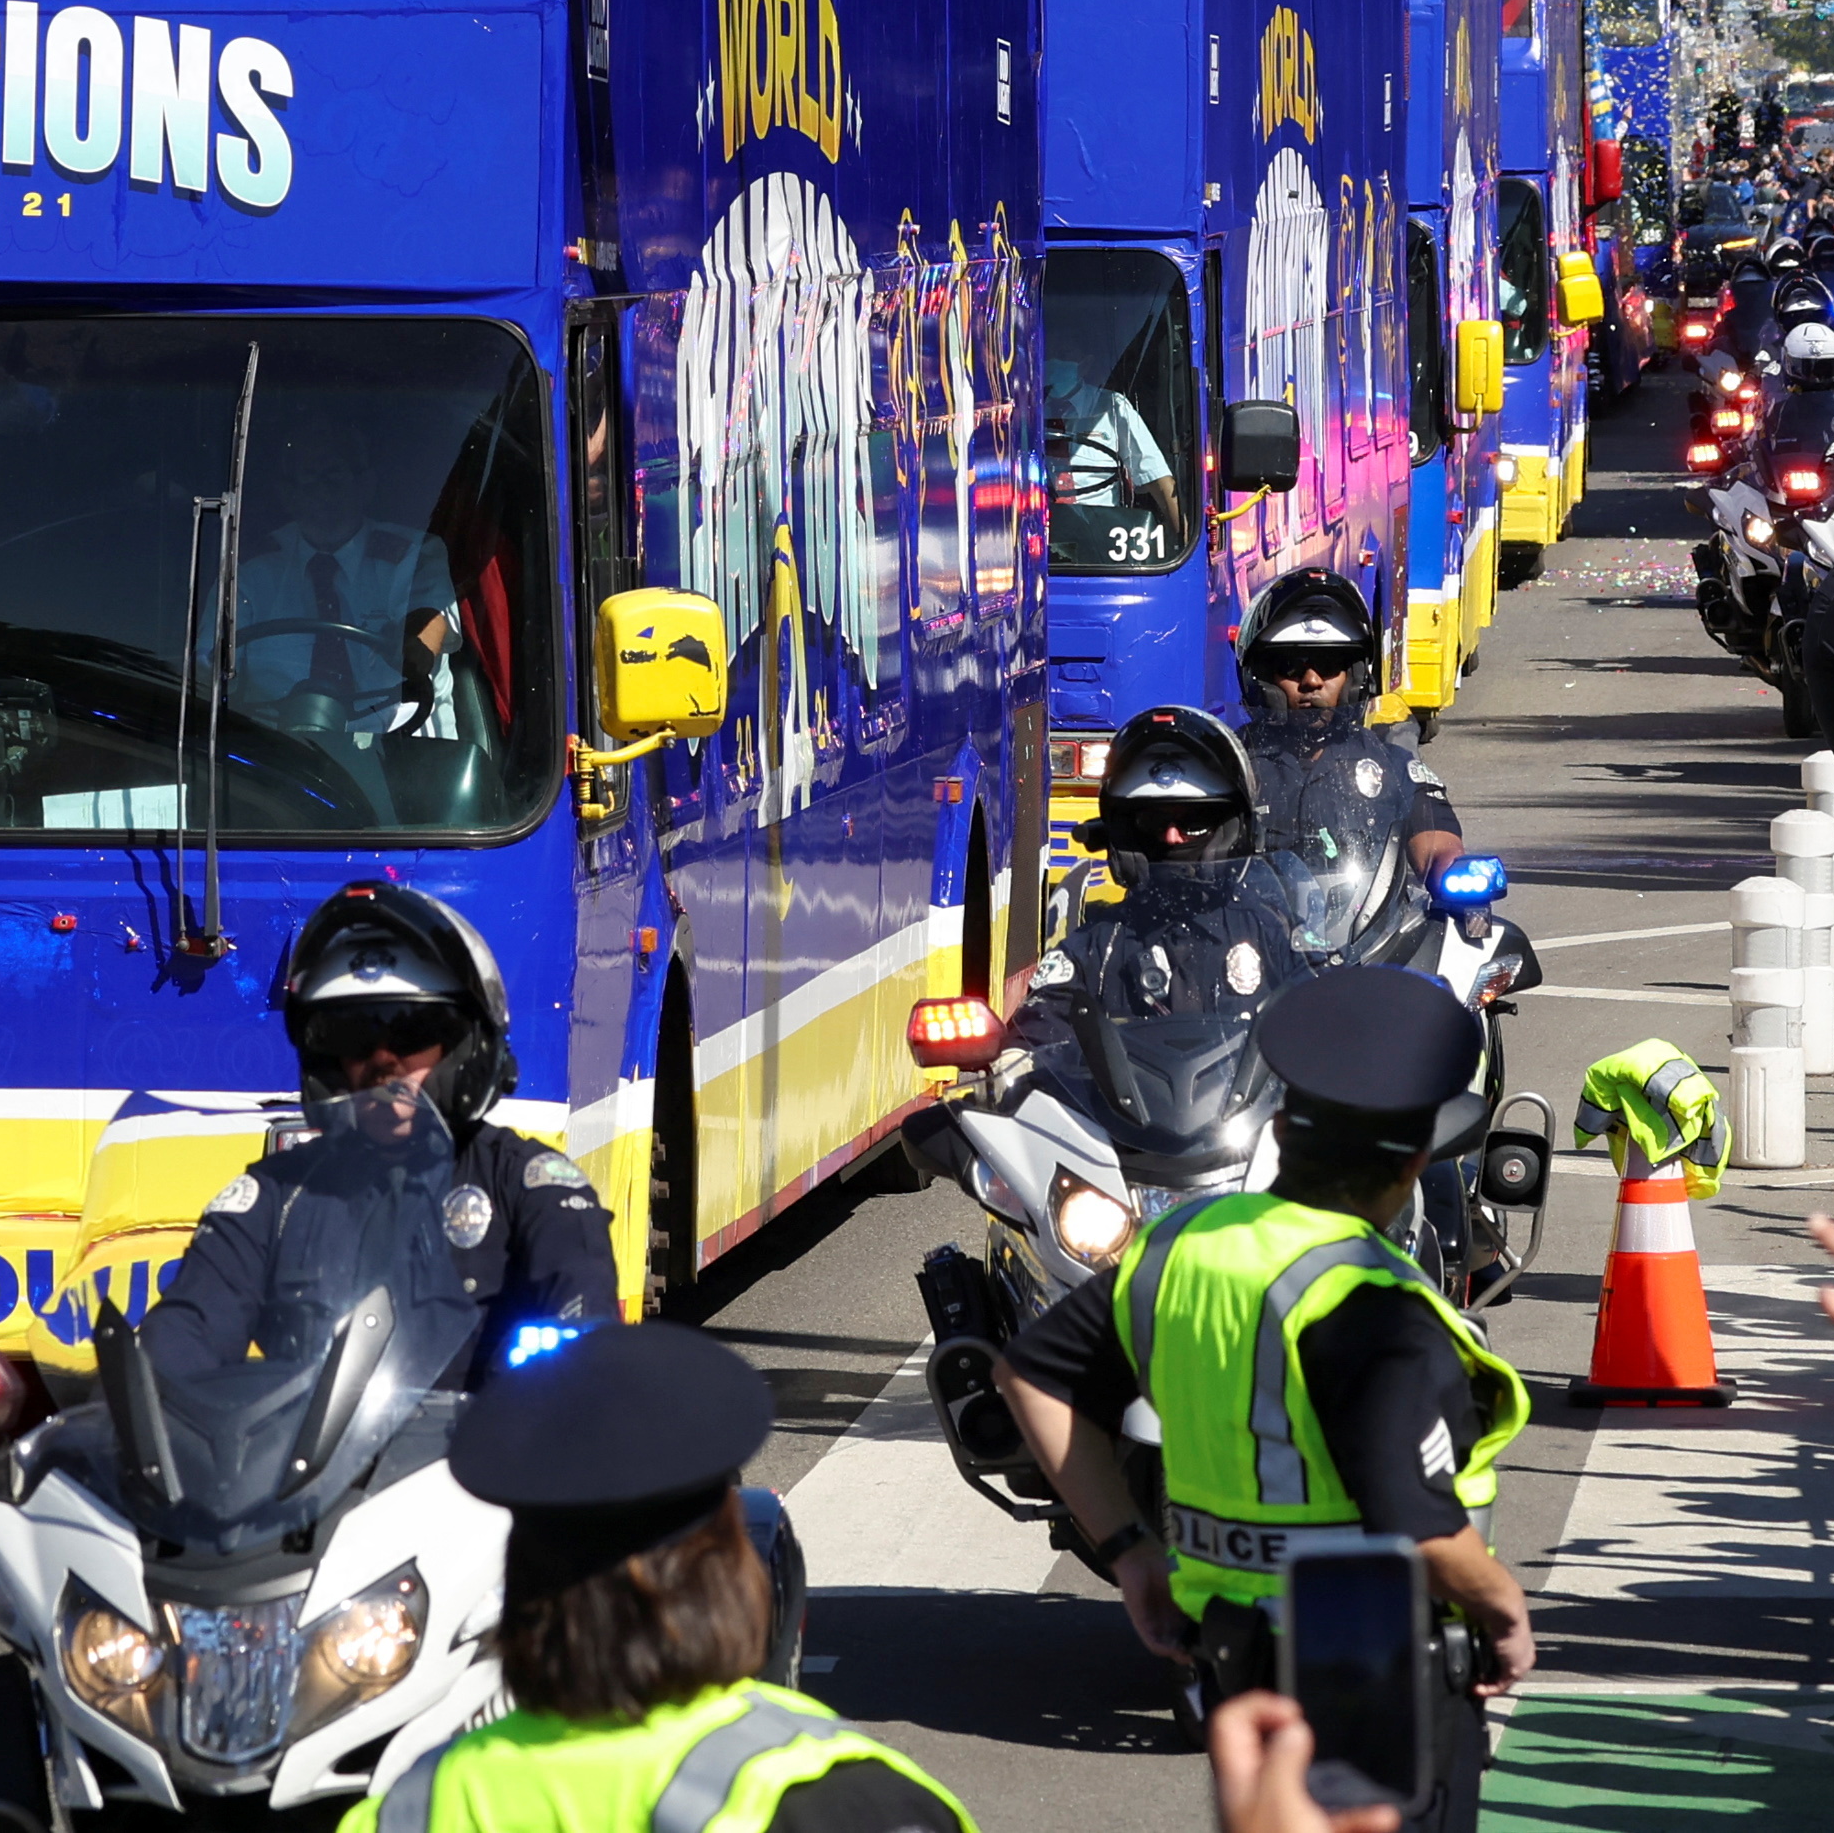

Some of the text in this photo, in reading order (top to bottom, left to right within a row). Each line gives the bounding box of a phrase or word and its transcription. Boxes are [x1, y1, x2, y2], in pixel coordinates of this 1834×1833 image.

[1260, 4, 1316, 147] WORLD
[21, 191, 73, 218] 21
[1107, 523, 1166, 562] 331
